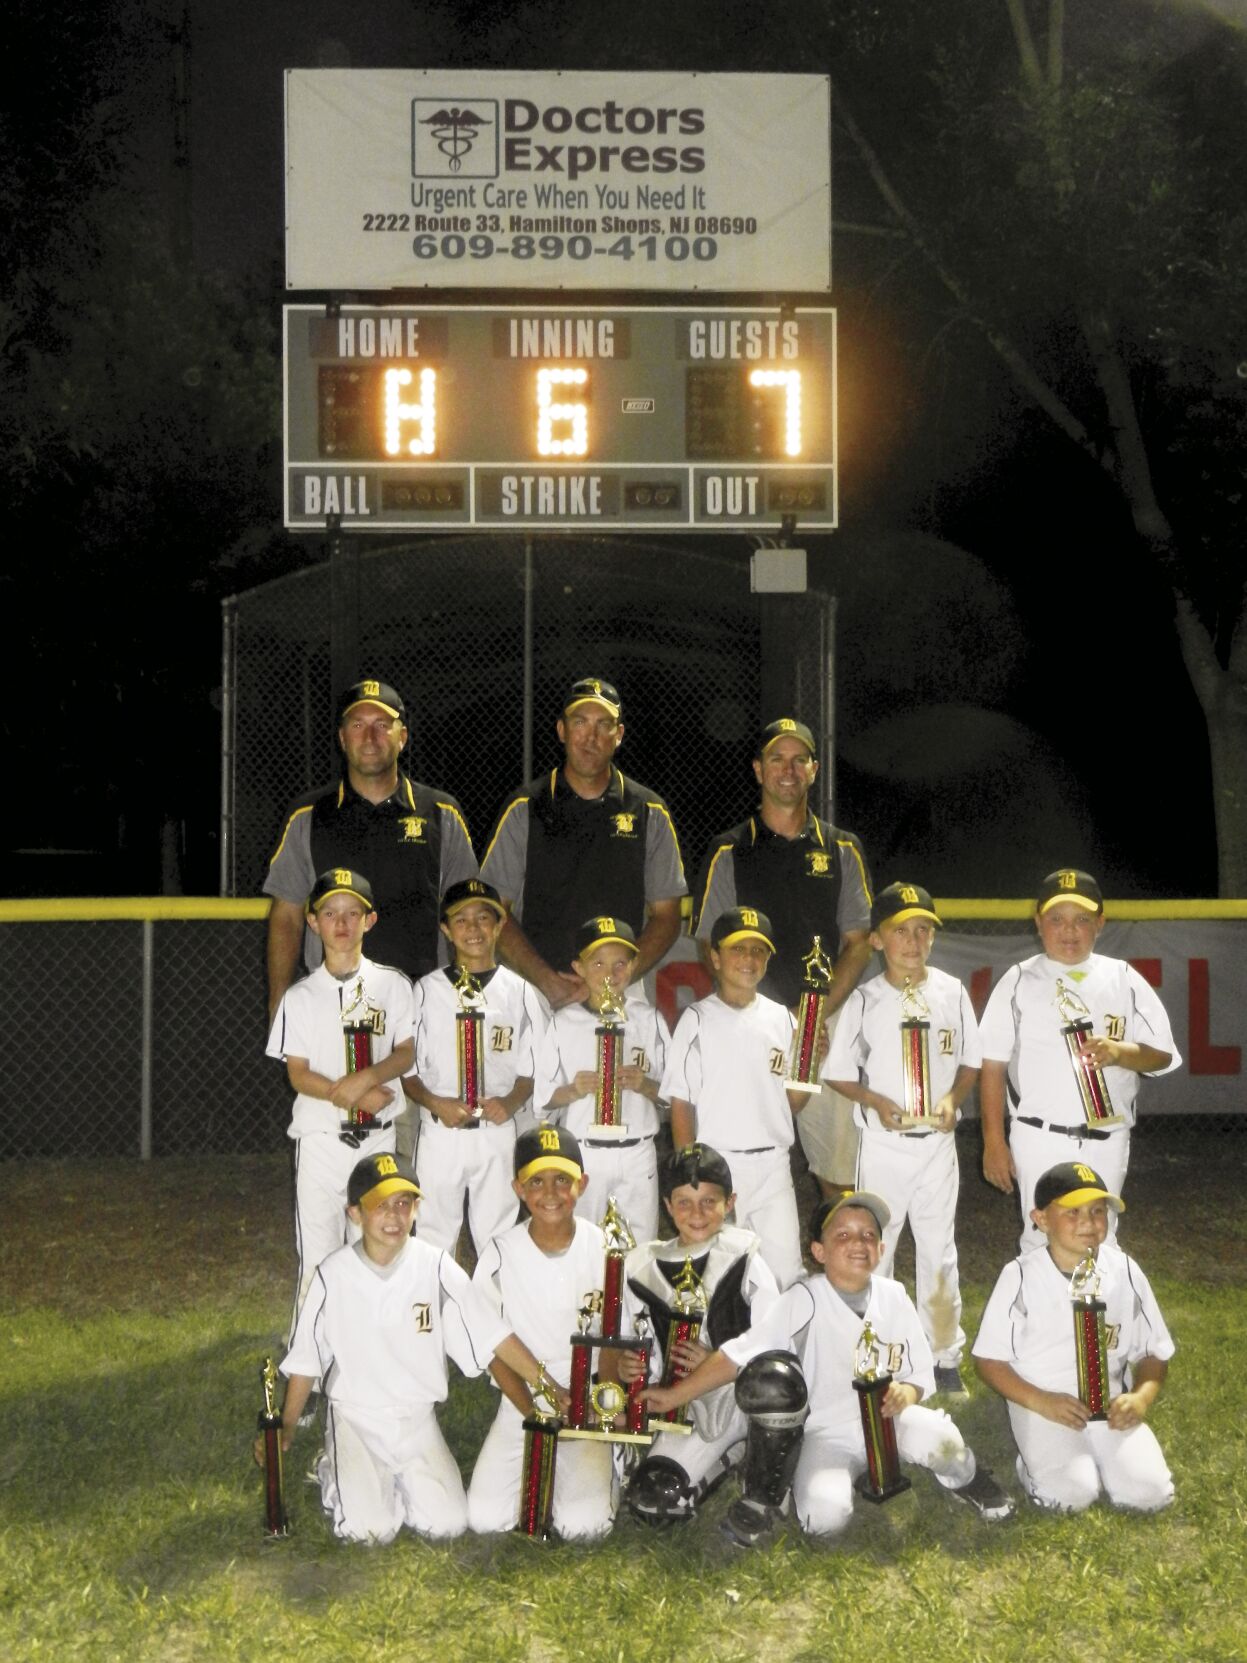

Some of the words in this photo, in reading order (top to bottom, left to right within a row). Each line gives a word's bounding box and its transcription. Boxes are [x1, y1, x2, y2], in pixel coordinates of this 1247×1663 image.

[504, 99, 706, 135] Doctors
[504, 137, 706, 180] Express
[411, 182, 476, 213] Urgent
[482, 183, 528, 209] Care
[534, 183, 589, 209] When
[595, 184, 632, 210] You
[636, 184, 686, 210] Need
[692, 185, 706, 210] It
[363, 215, 410, 232] 2222
[414, 215, 471, 233] Route
[476, 215, 504, 234] 33,
[510, 215, 597, 234] Hamilton
[601, 216, 665, 236] Shops,
[669, 217, 690, 234] NJ
[694, 217, 757, 235] 08690
[412, 234, 718, 261] 609-890-4100
[338, 318, 419, 358] HOME
[509, 319, 615, 359] INNING
[689, 320, 800, 360] GUESTS
[536, 366, 588, 456] 6
[749, 368, 802, 457] 7
[304, 476, 370, 516] BALL
[501, 476, 603, 516] STRIKE
[705, 477, 759, 517] OUT
[335, 870, 353, 885] B
[1058, 871, 1077, 890] B
[899, 887, 920, 903] B
[597, 917, 616, 933] B
[740, 909, 759, 927] B
[491, 1025, 514, 1052] B
[538, 1129, 560, 1150] B
[374, 1154, 399, 1176] B
[1072, 1163, 1097, 1183] B
